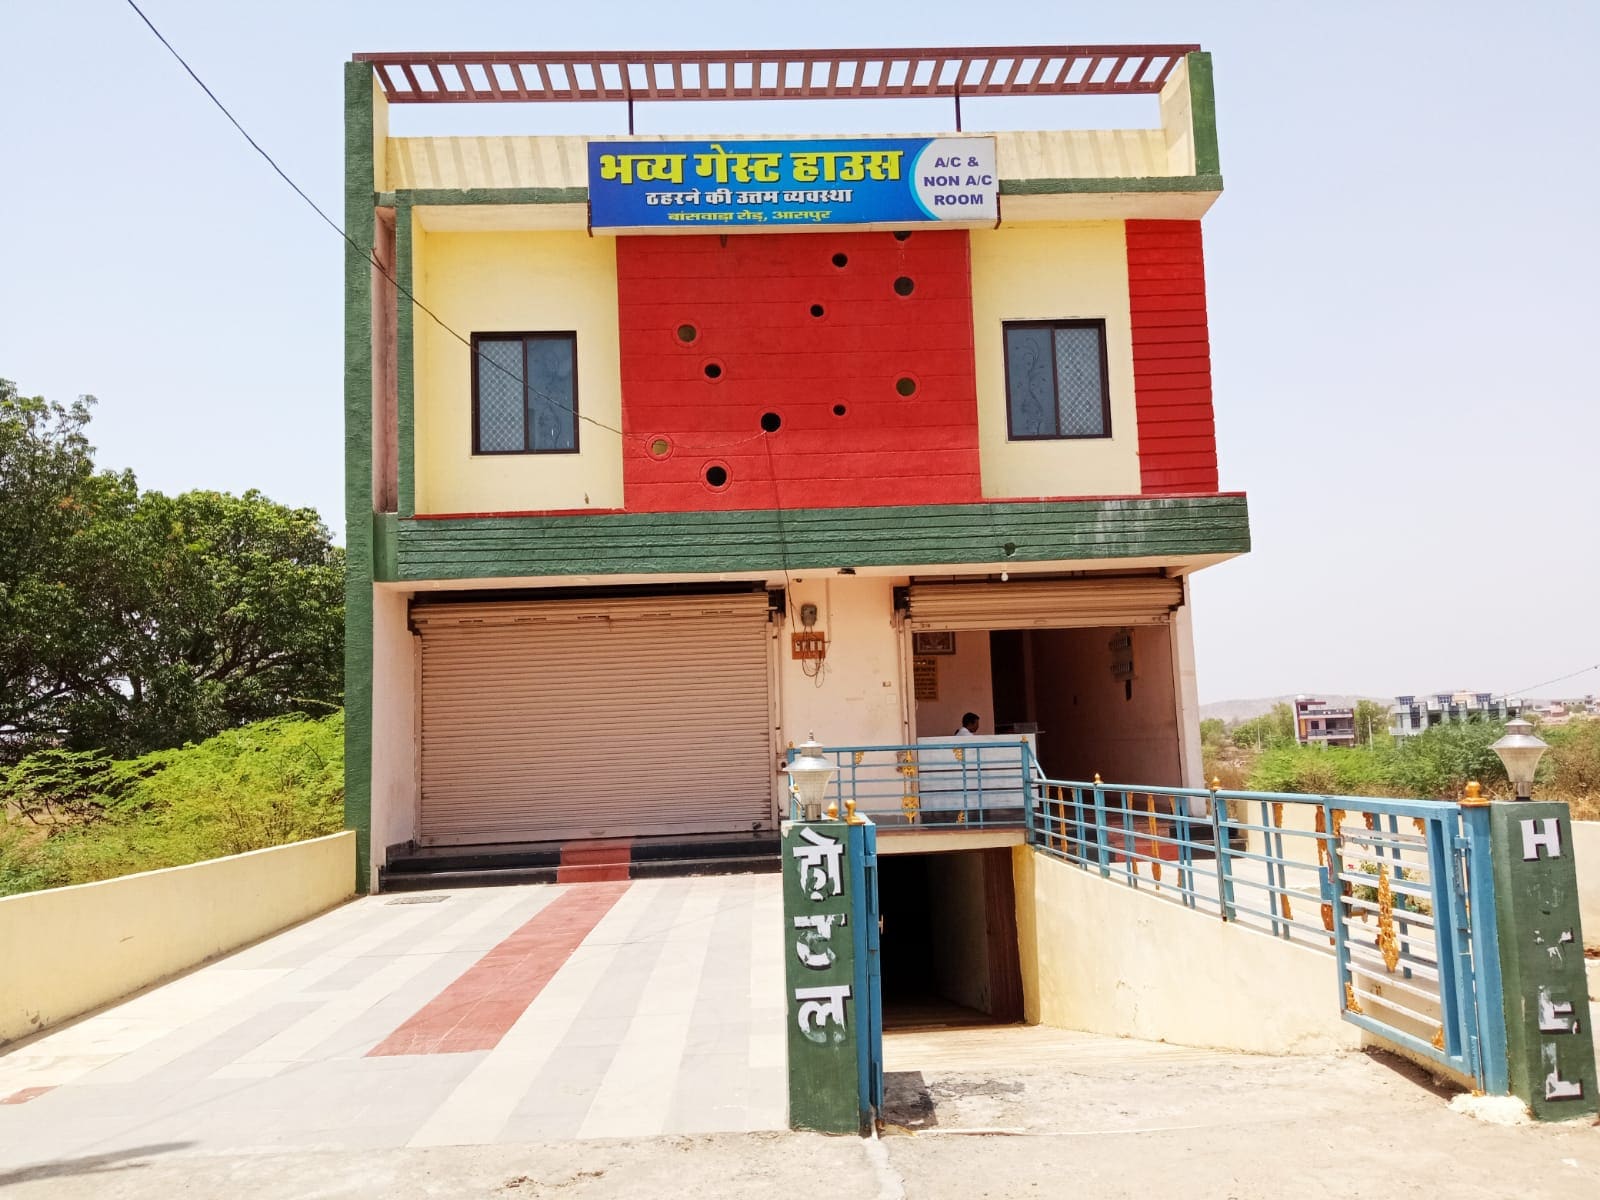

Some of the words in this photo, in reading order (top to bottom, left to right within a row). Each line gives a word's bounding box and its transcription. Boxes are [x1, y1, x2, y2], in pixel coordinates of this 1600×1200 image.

[600, 153, 687, 183] भव्य
[693, 143, 782, 183] गेस्ट
[790, 150, 903, 182] हाउस
[935, 156, 961, 168] A/C
[967, 156, 979, 167] &
[923, 175, 960, 187] NON
[965, 175, 992, 186] A/C
[645, 188, 699, 205] ठहरने
[705, 188, 734, 205] की
[737, 190, 779, 204] उत्तम
[783, 189, 853, 204] व्यवस्था
[934, 194, 983, 206] ROOM
[772, 210, 832, 222] आसपुर
